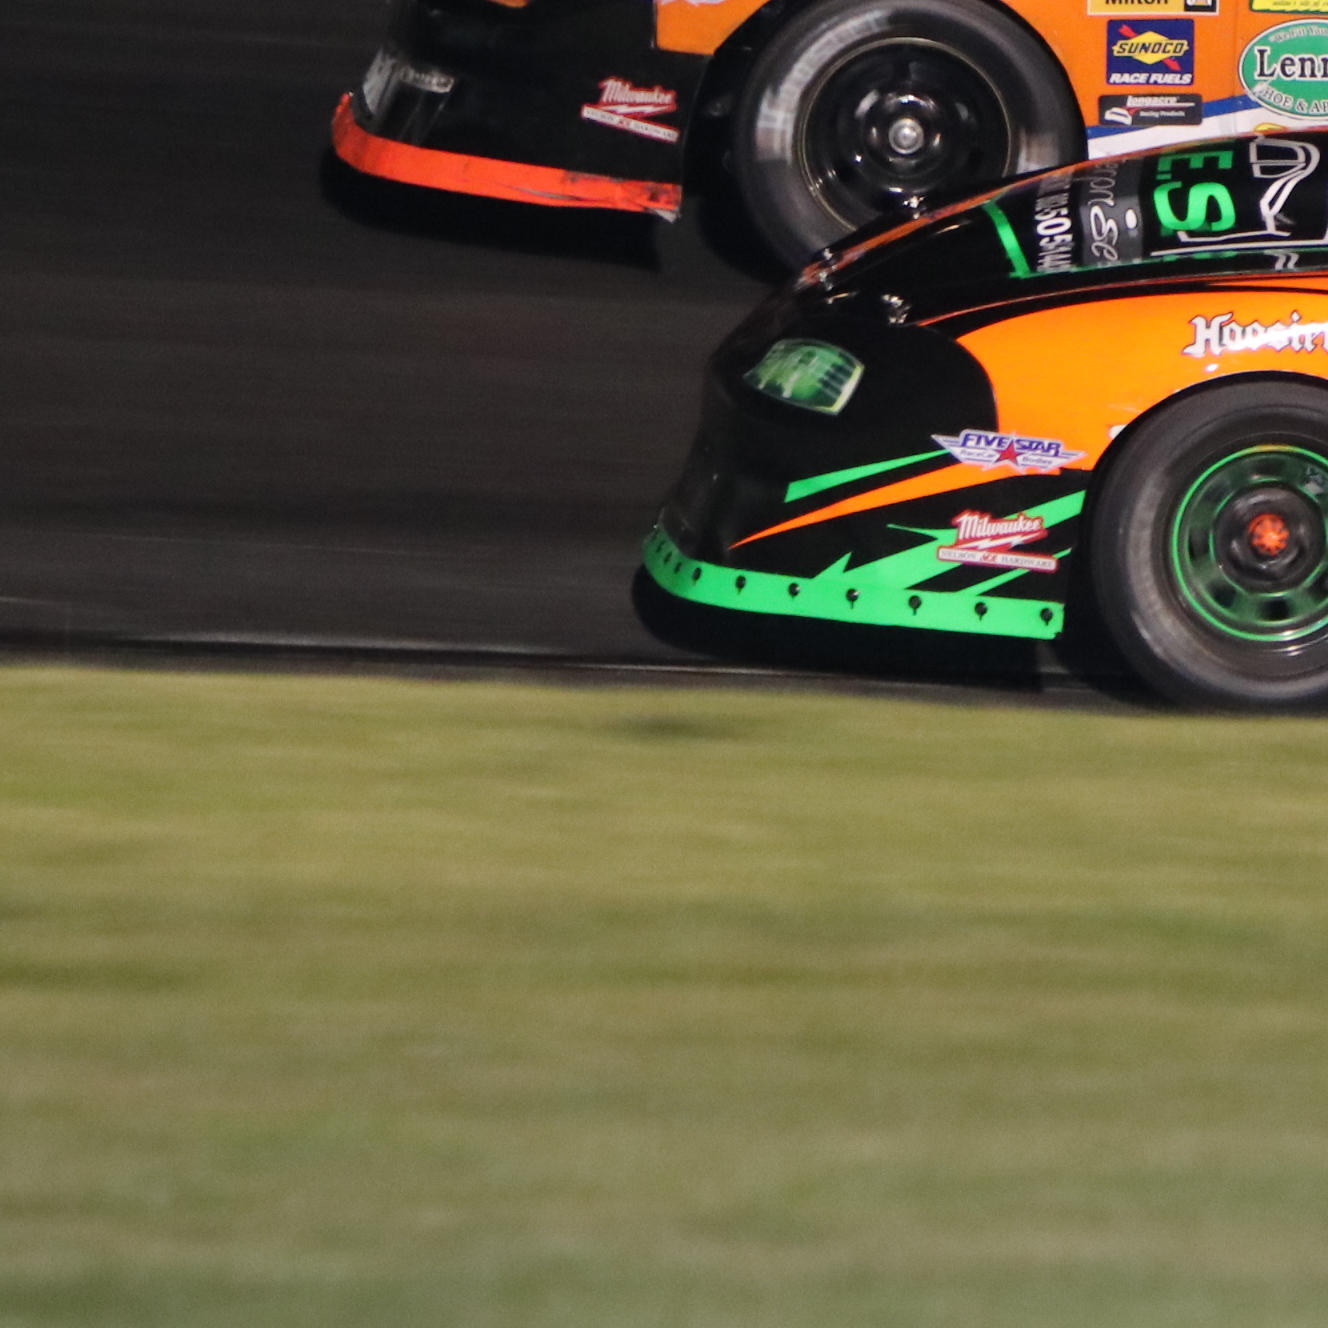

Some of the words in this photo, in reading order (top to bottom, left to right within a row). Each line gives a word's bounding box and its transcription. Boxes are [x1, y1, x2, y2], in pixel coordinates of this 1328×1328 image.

[1309, 25, 1327, 35] You
[1116, 42, 1185, 54] SUNOCO
[1109, 73, 1149, 84] RACE
[1149, 73, 1193, 85] FUELS
[1254, 83, 1293, 109] HOE
[1297, 99, 1307, 113] &
[961, 433, 1007, 448] FIVE
[1016, 439, 1061, 457] STAR
[954, 513, 1042, 540] Milwaukee
